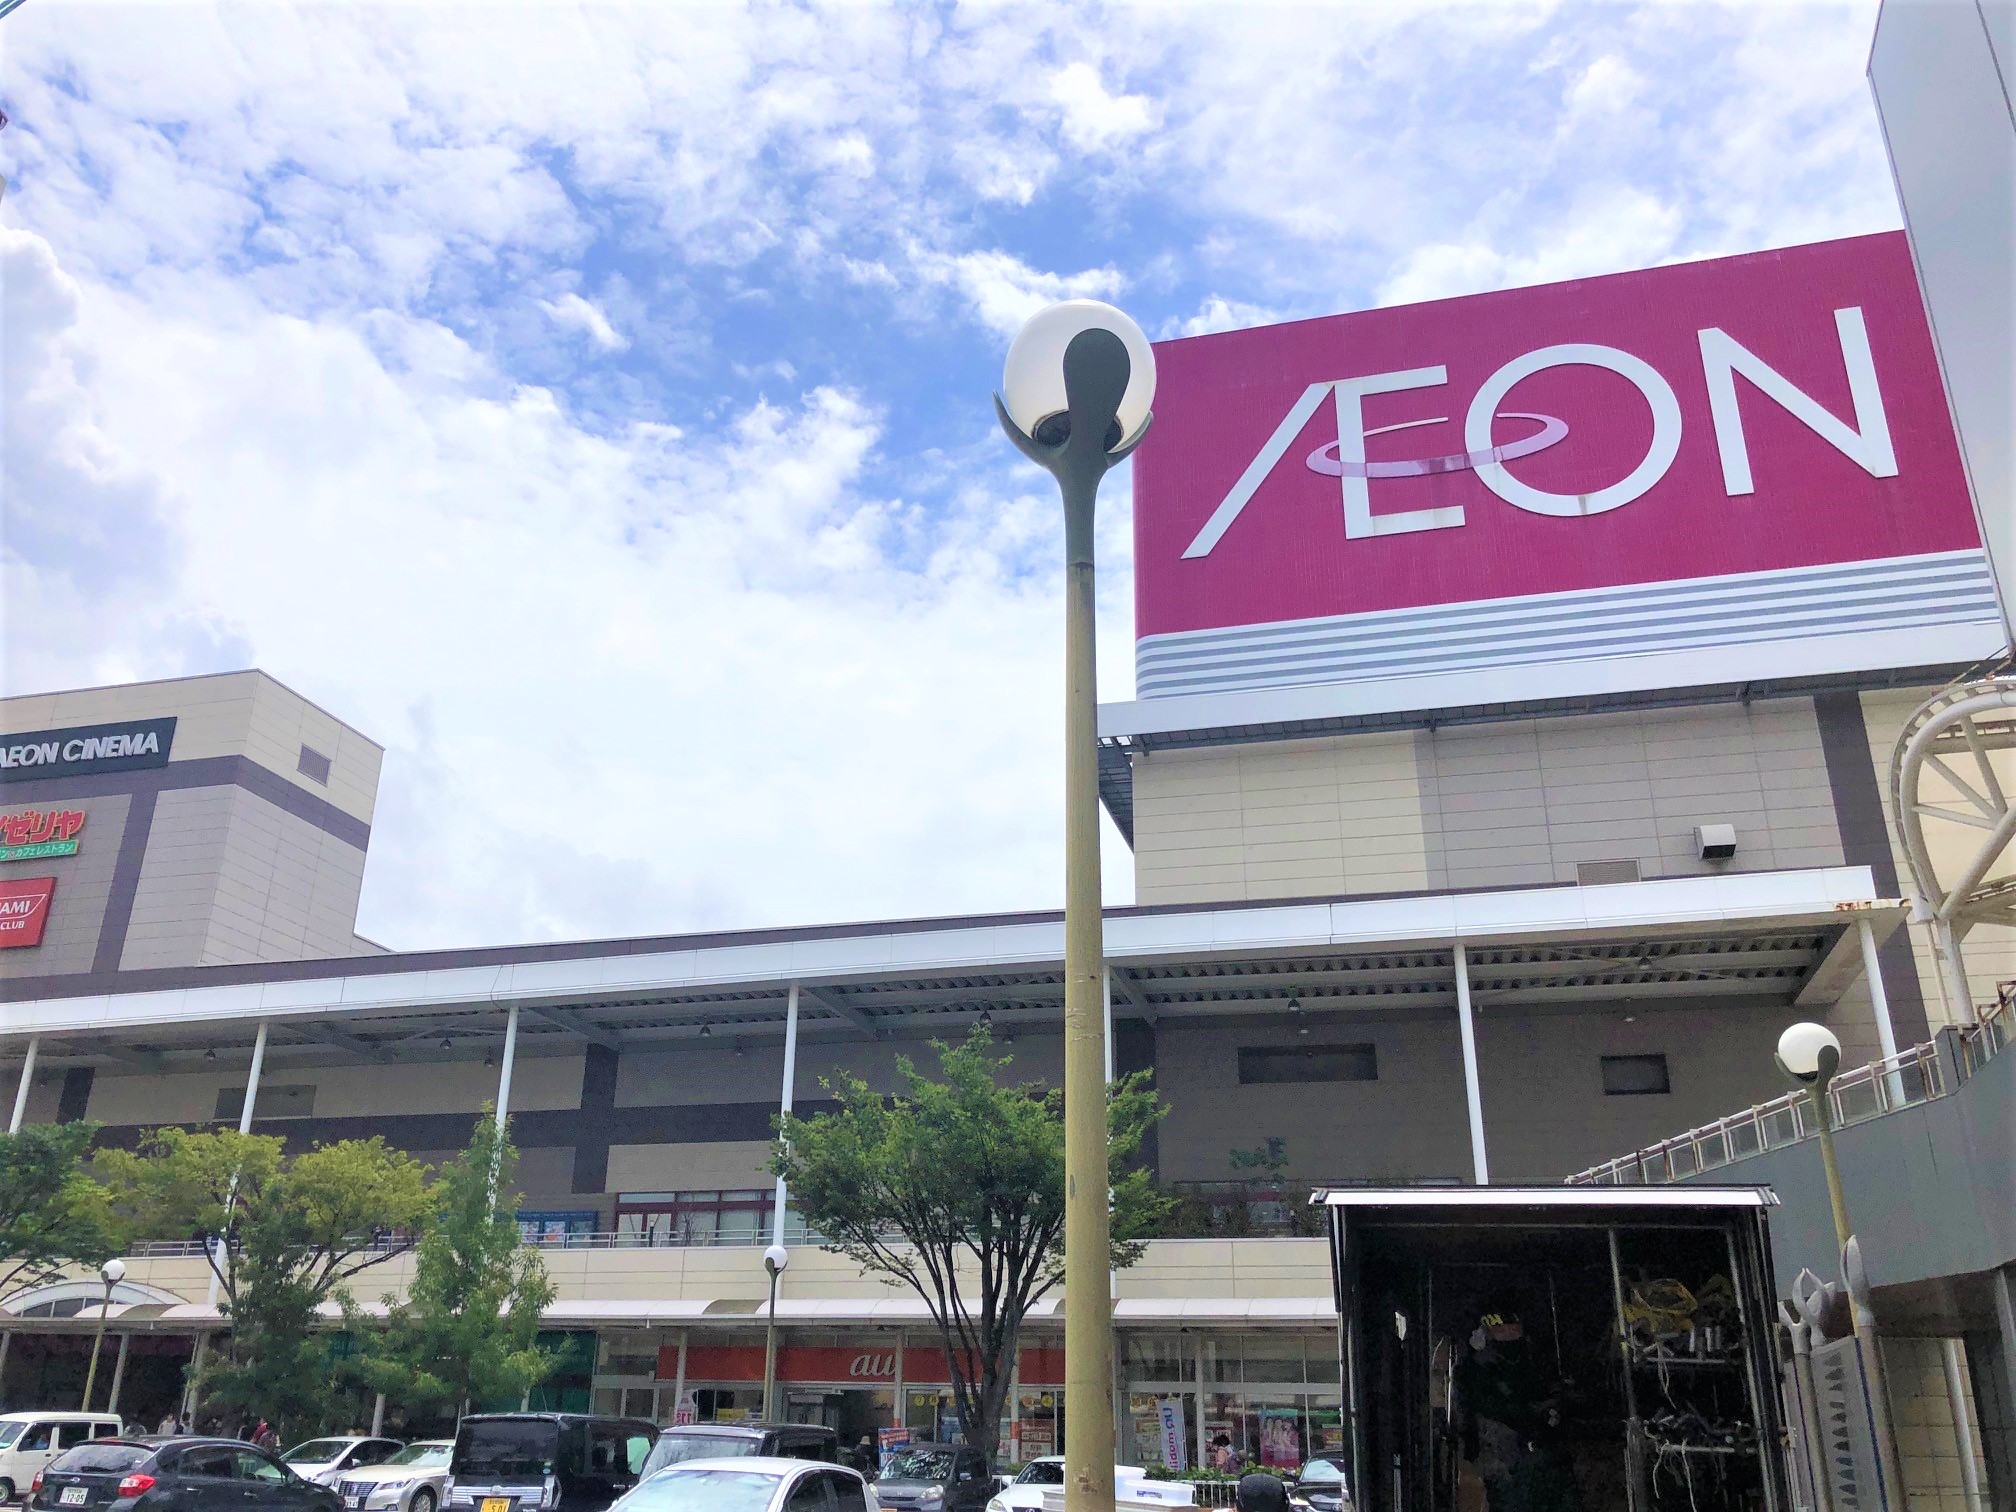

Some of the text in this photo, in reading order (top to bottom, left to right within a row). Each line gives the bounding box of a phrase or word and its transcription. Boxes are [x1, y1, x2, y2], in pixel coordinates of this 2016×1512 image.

[62, 732, 159, 762] CINEMA
[0, 844, 74, 859] ン&カフェレストラン
[0, 901, 31, 915] AMI
[0, 921, 25, 930] CLUB
[850, 1355, 896, 1376] au
